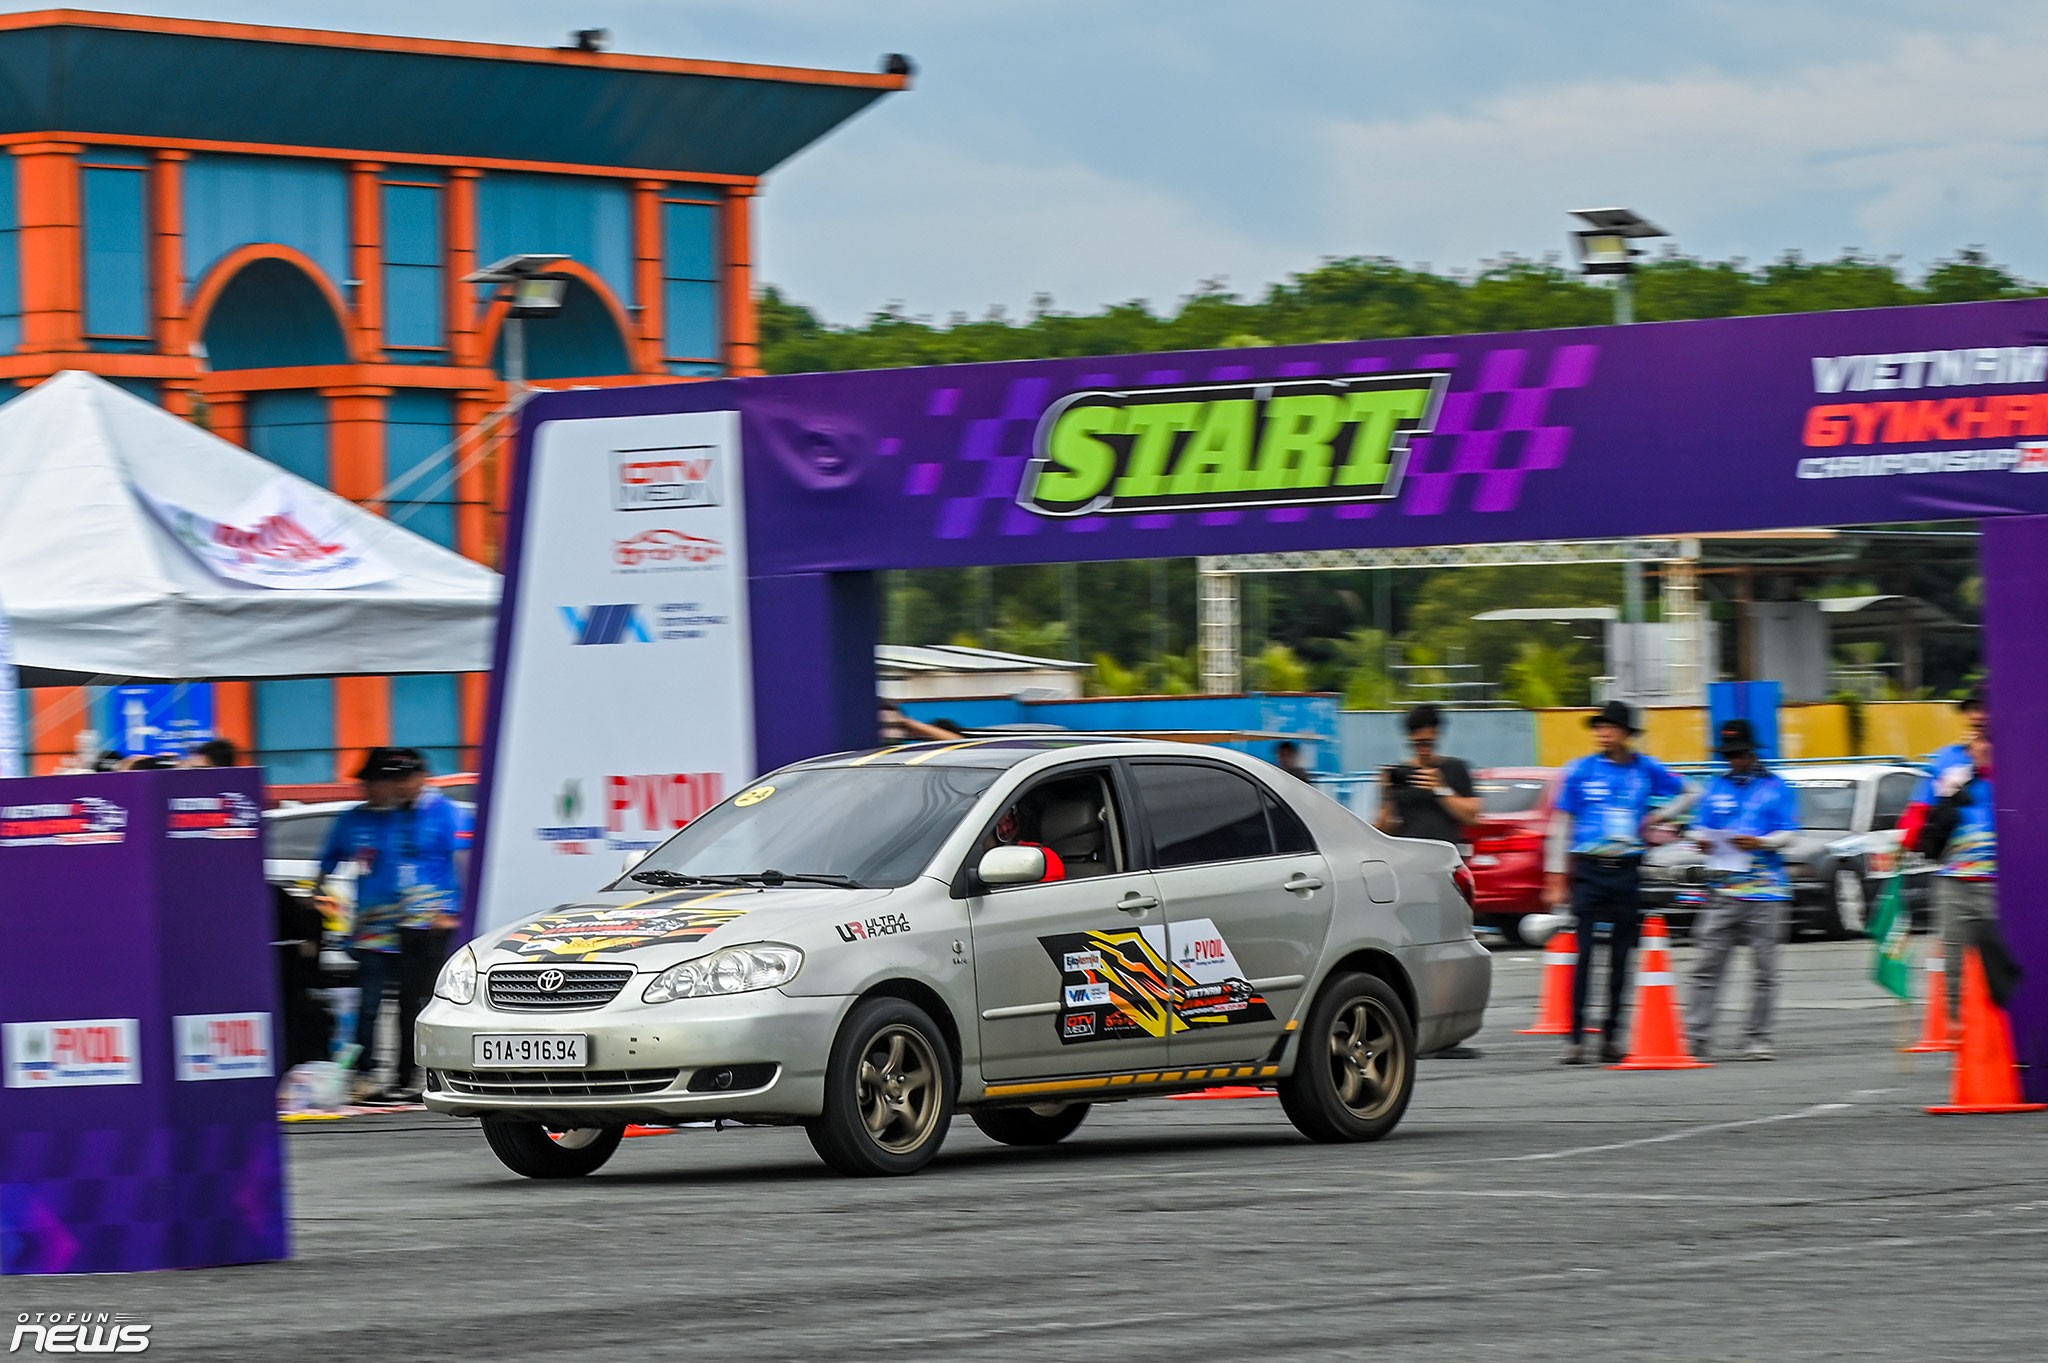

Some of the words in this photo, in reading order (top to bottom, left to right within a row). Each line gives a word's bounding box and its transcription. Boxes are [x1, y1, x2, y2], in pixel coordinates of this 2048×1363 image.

[1811, 346, 2047, 394] VIETNAM
[1802, 393, 2048, 447] GYMKHA
[1031, 388, 1432, 502] START
[864, 912, 906, 928] ULTRA
[867, 921, 912, 939] RACING
[834, 921, 868, 943] UR
[1195, 938, 1225, 961] PVOIL
[483, 1040, 577, 1061] 61A-916.94
